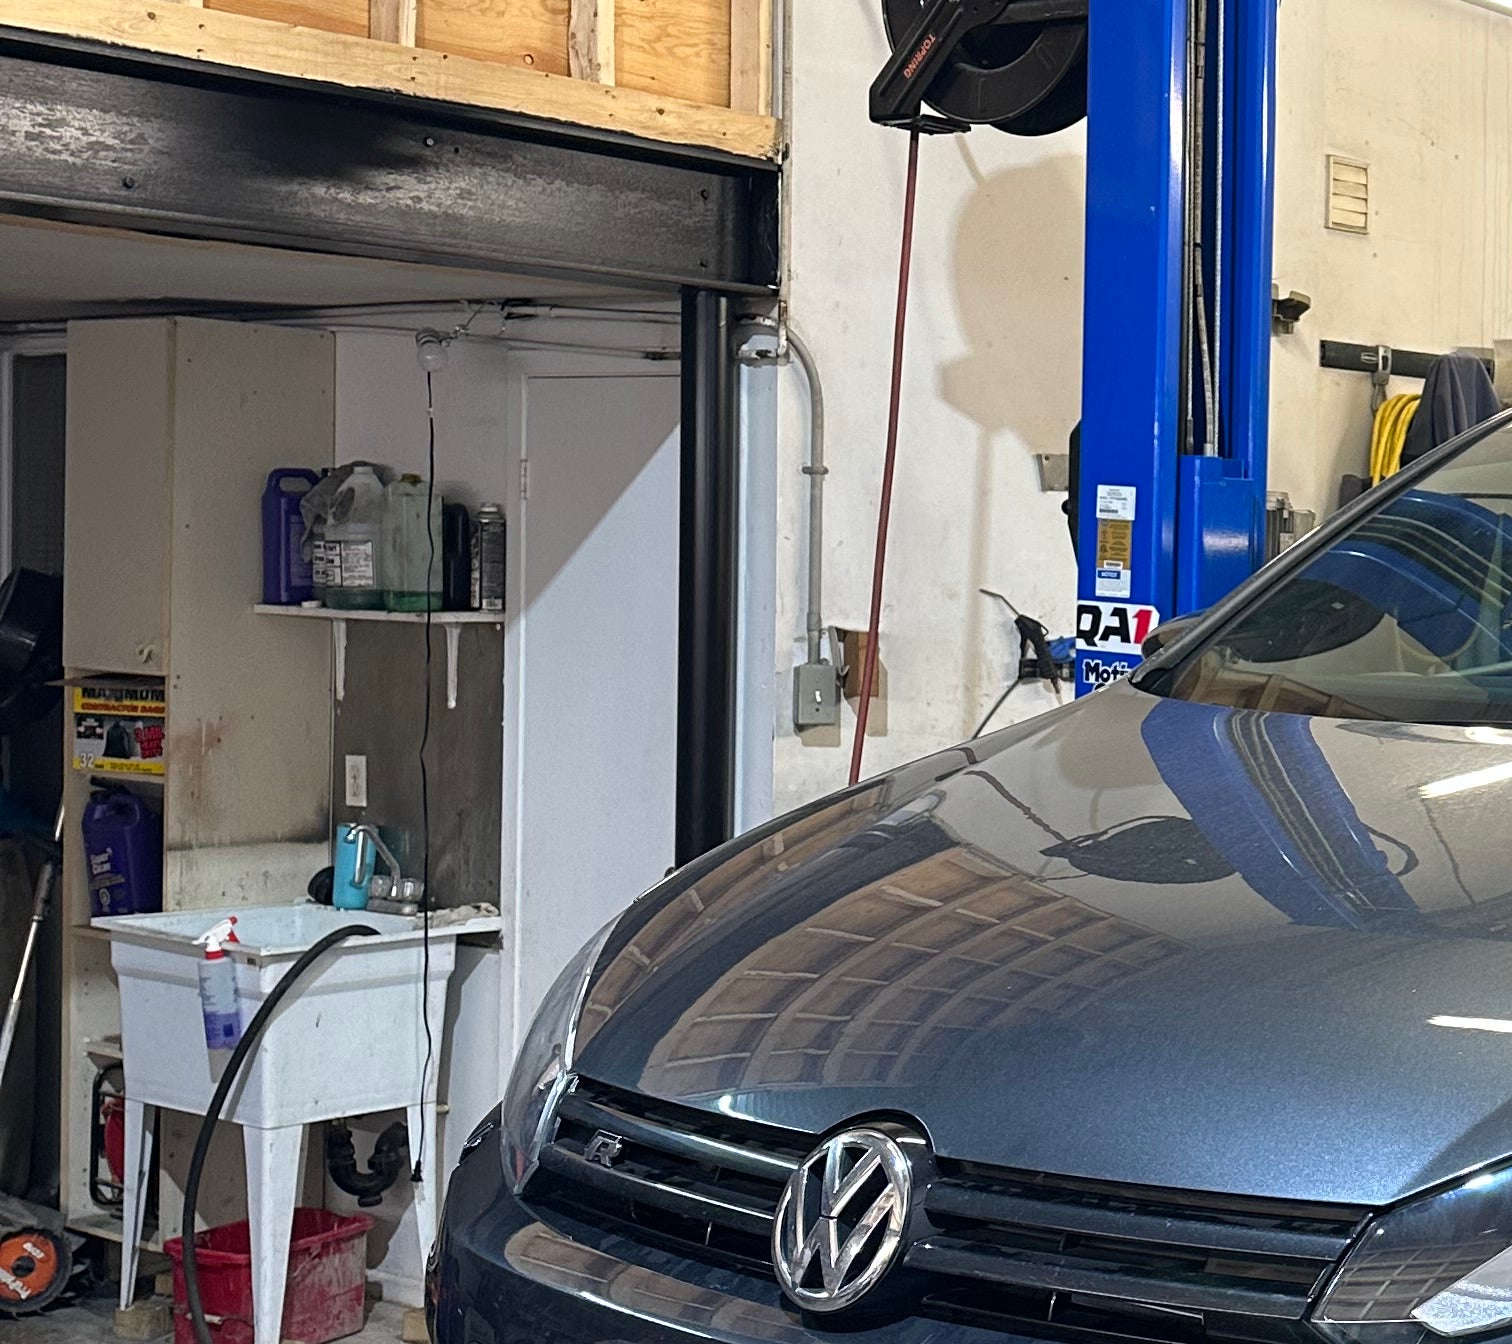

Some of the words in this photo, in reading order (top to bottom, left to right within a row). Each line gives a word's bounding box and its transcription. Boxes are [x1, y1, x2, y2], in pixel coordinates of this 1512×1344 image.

[903, 33, 936, 79] TOPRING
[1076, 604, 1153, 646] QA1
[80, 753, 95, 768] 32
[584, 1129, 622, 1168] R
